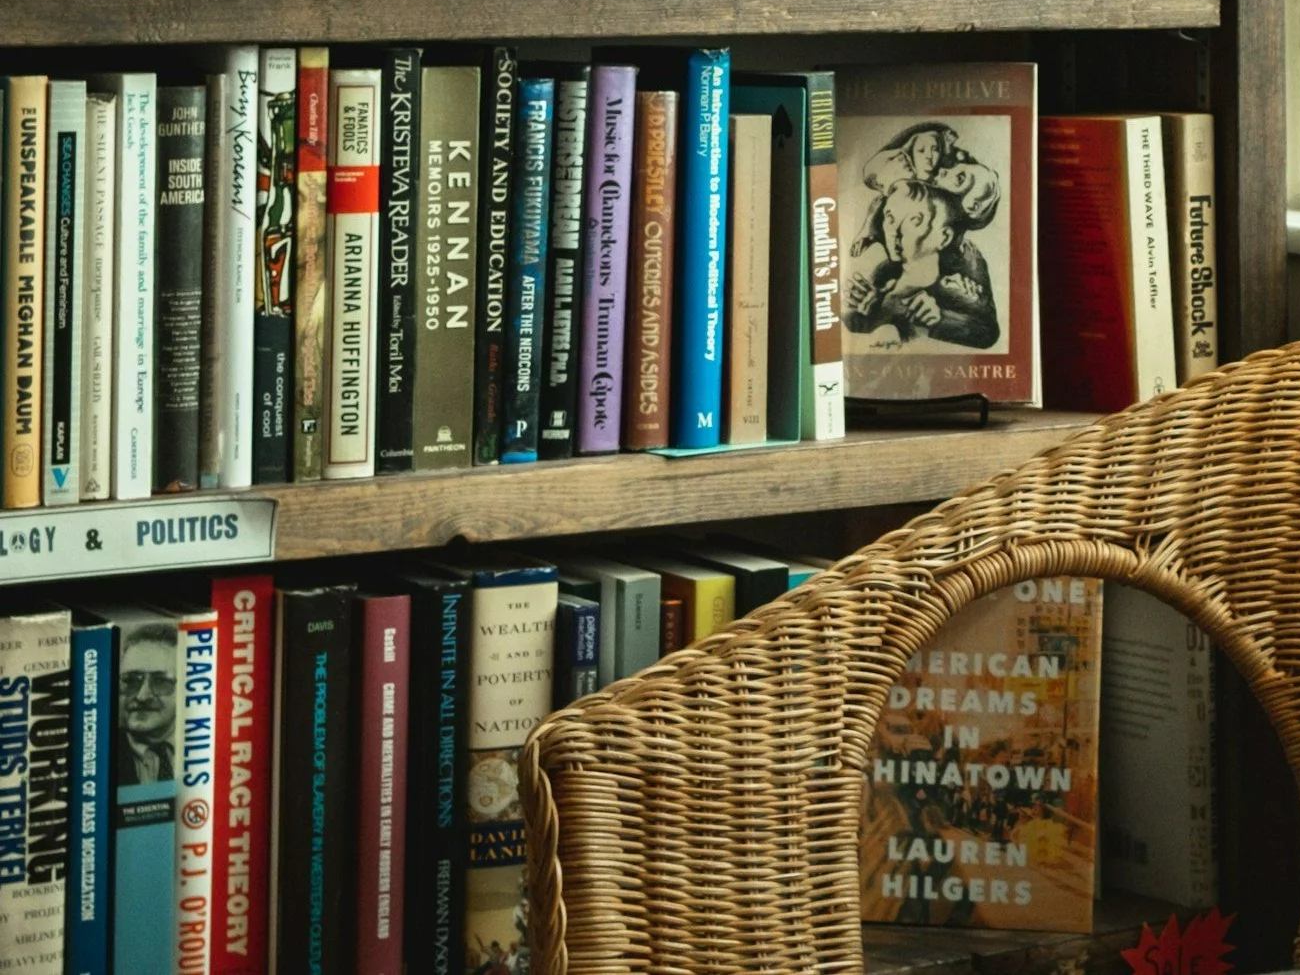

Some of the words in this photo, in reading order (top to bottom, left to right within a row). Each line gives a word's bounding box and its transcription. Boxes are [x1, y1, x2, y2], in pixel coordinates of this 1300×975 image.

[394, 57, 412, 91] The
[712, 66, 723, 86] An
[21, 108, 36, 116] THE
[344, 106, 354, 114] &
[494, 59, 513, 150] SOCIETY
[811, 89, 835, 151] ERIKSON
[343, 117, 354, 151] FOOLS
[356, 102, 369, 154] FANATICS
[390, 93, 411, 196] KRISTEVA
[711, 89, 722, 175] Introduction
[1140, 127, 1151, 151] THE
[168, 174, 202, 189] SOUTH
[169, 158, 202, 172] INSIDE
[428, 141, 443, 232] MEMOIRS
[492, 157, 508, 203] AND
[710, 176, 720, 192] to
[1141, 153, 1152, 189] THIRD
[19, 118, 37, 264] UNSPEAKABLE
[160, 191, 204, 206] AMERICA
[1143, 193, 1154, 229] WAVE
[388, 200, 410, 288] READER
[446, 140, 471, 329] KENNAN
[708, 194, 720, 249] Modern
[1189, 193, 1211, 264] Future
[343, 233, 363, 314] ARIANNA
[487, 211, 506, 333] EDUCATION
[1146, 236, 1156, 266] Alvin
[425, 235, 440, 331] 1925-1950
[520, 275, 536, 311] AFTER
[708, 251, 719, 308] Political
[1147, 270, 1158, 310] Toffler
[1190, 265, 1215, 336] Shock
[17, 275, 35, 369] MEGHAN
[520, 312, 533, 335] THE
[815, 279, 840, 332] Truth
[705, 311, 718, 361] Theory
[276, 353, 285, 372] the
[341, 322, 361, 435] HUFFINGTON
[517, 337, 532, 392] NEOCONS
[15, 375, 33, 435] DAUM
[263, 392, 272, 407] of
[274, 377, 285, 436] conquest
[263, 411, 271, 437] cool
[85, 529, 103, 551] &
[136, 513, 238, 546] POLITICS
[307, 620, 334, 633] DAVIS
[480, 621, 555, 637] WEALTH
[184, 630, 213, 706] PEACE
[231, 591, 256, 737] CRITICAL
[477, 669, 552, 686] POVERTY
[510, 698, 524, 706] OF
[889, 688, 1038, 715] DREAMS
[183, 717, 211, 788] KILLS
[944, 726, 980, 750] IN
[229, 744, 252, 828] RACE
[888, 836, 1029, 868] LAUREN
[226, 832, 250, 956] THEORY
[882, 875, 1033, 906] HILGERS
